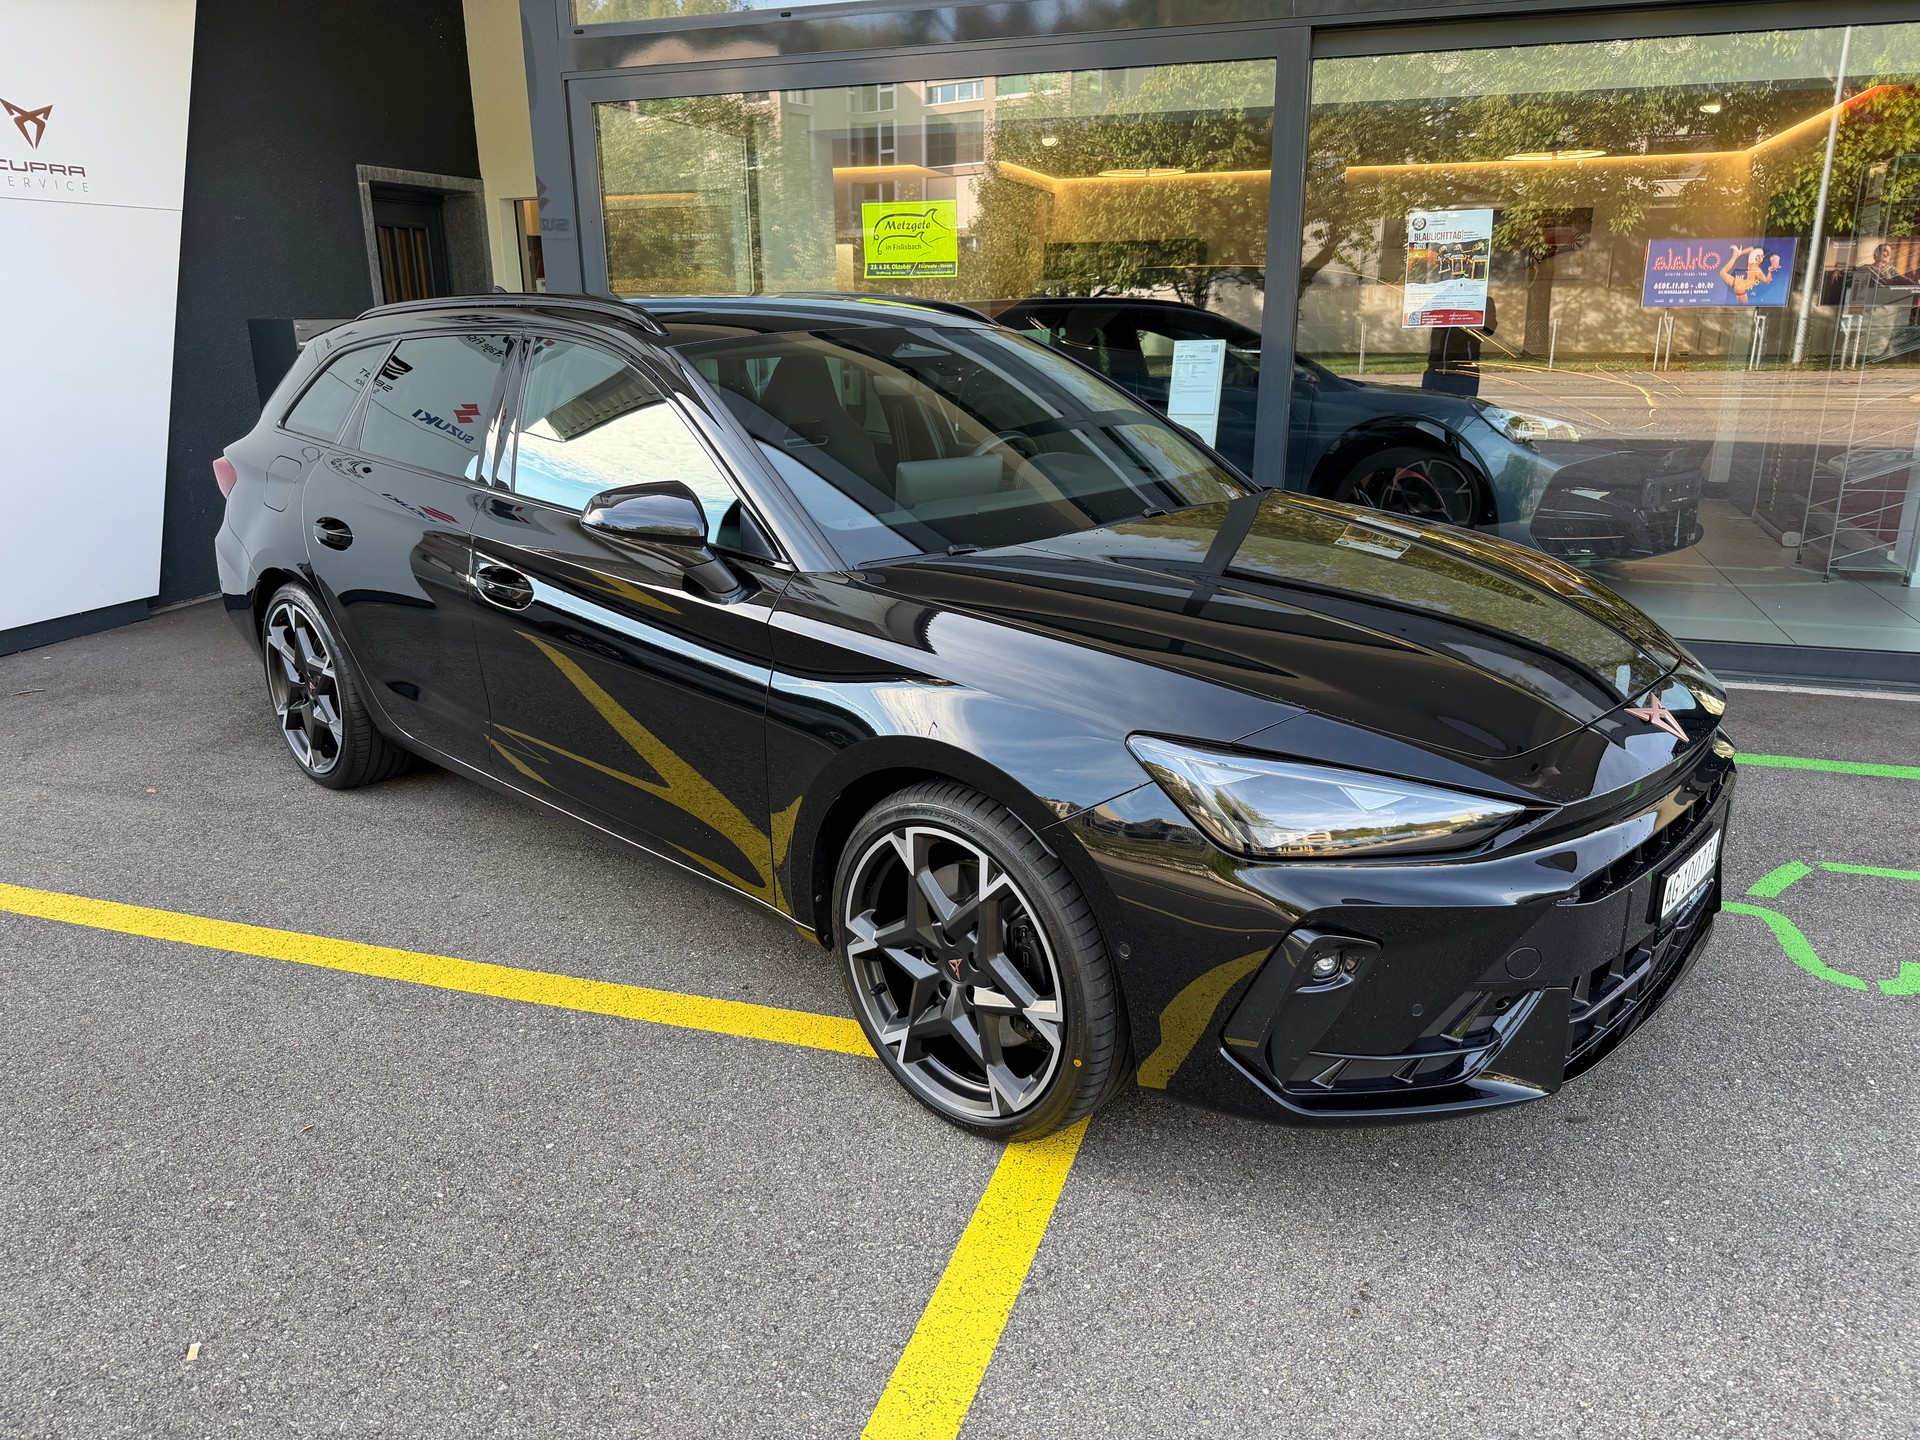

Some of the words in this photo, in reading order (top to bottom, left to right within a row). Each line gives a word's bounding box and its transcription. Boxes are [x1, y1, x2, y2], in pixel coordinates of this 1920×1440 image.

[7, 175, 89, 193] ERVICE
[884, 220, 931, 232] Metzgete
[1414, 231, 1462, 242] BLAULICHTTAG
[893, 243, 922, 251] Fislisbach
[1664, 873, 1681, 912] AG
